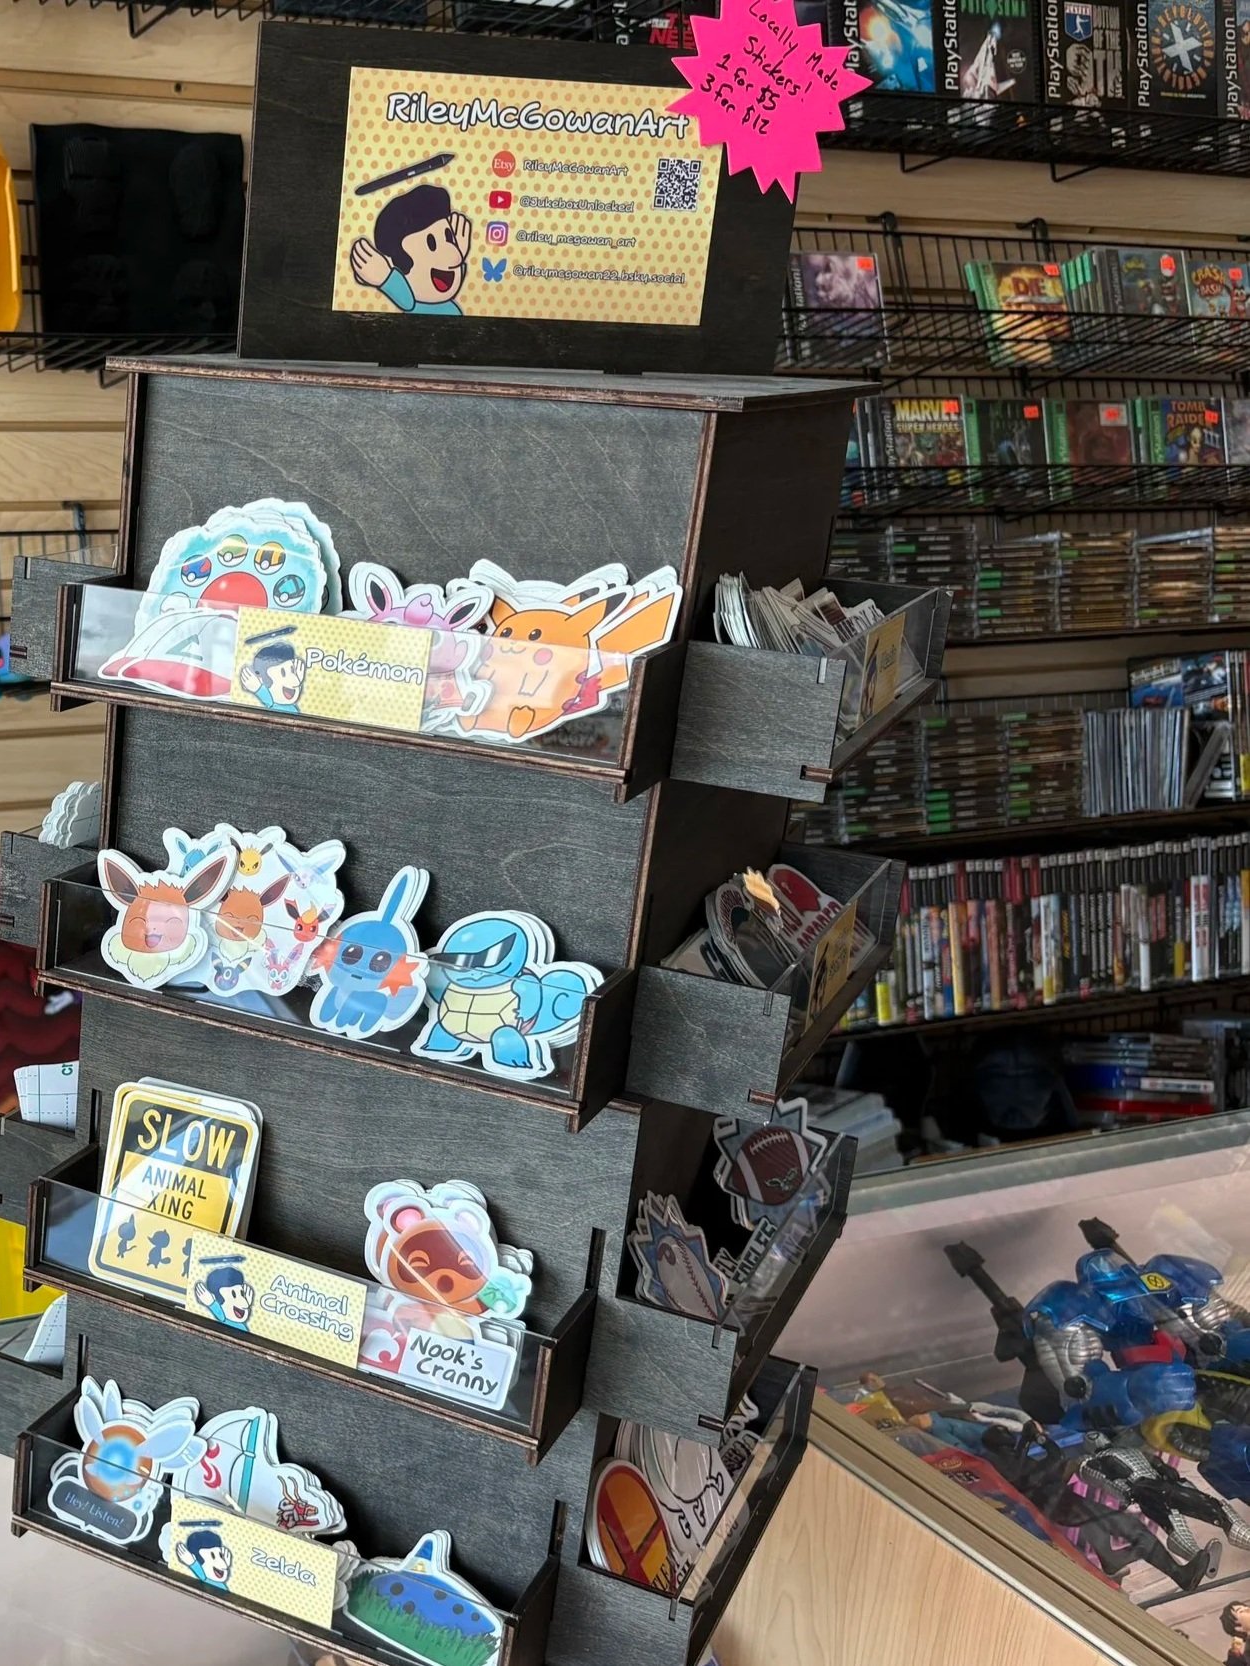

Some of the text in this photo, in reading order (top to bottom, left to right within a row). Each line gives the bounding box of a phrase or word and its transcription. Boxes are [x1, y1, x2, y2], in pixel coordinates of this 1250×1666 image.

[749, 0, 840, 91] Locally Made
[1134, 2, 1153, 107] PlayStation
[715, 53, 781, 111] 1 for $5
[1225, 17, 1241, 119] PlayStation
[386, 91, 690, 139] RileyMcGowanArt
[700, 73, 770, 135] 3 for $12
[493, 158, 515, 173] Etsy
[522, 159, 629, 177] RileyMcGowanArt
[519, 195, 635, 213] @JukeboxUnlocked
[516, 229, 637, 249] @riley_mcgowan_art
[512, 264, 686, 285] @rileymcgowan22.bsky.social
[305, 646, 424, 687] Pokémon
[138, 1109, 236, 1169] SLOW
[141, 1165, 208, 1200] ANIMAL
[147, 1190, 195, 1220] XING
[270, 1275, 349, 1316] Animal
[259, 1292, 354, 1343] Crossing
[409, 1334, 483, 1370] Nook's
[416, 1356, 499, 1396] Cranny
[65, 1491, 125, 1529] Hey! Listen!
[250, 1547, 317, 1587] Zelda
